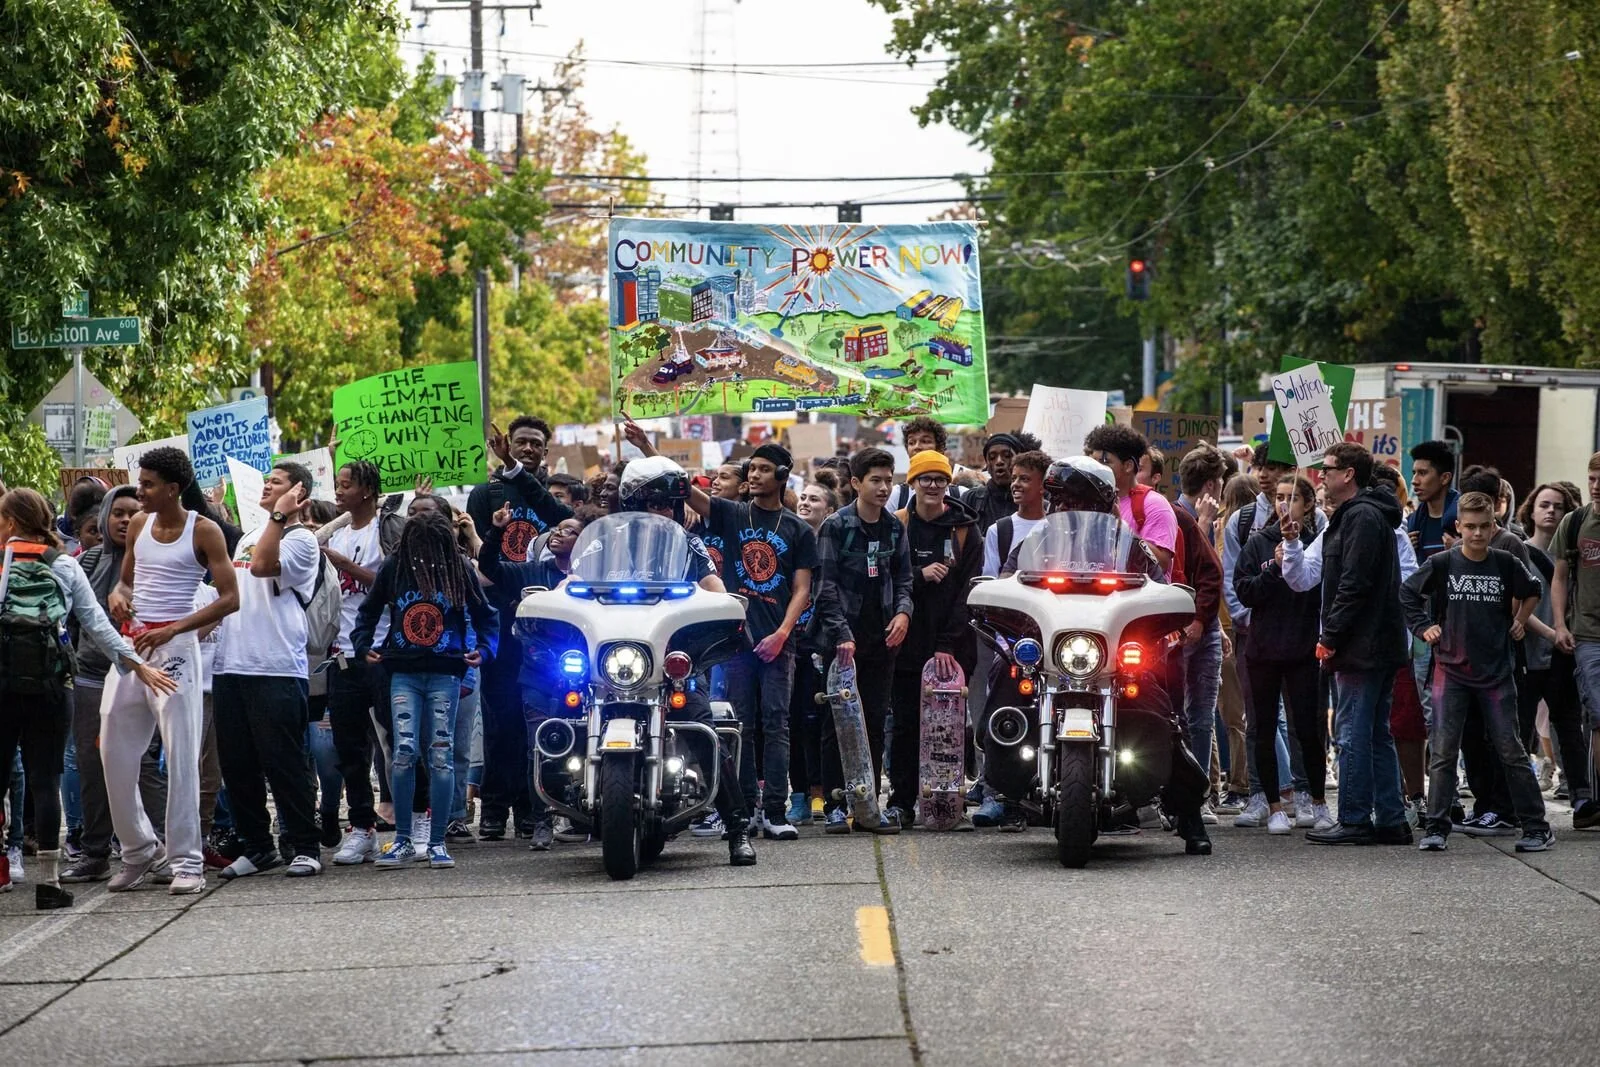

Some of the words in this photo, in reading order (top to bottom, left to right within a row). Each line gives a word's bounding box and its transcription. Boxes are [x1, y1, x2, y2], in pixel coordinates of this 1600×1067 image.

[614, 239, 776, 271] COMMUNITY
[791, 245, 889, 276] POWER
[899, 244, 972, 273] NOW!
[95, 327, 120, 341] Ave
[119, 319, 137, 329] 600
[378, 368, 425, 388] THE
[359, 382, 464, 409] CLIMATE
[340, 415, 365, 433] IS
[367, 404, 472, 425] CHANGING
[1298, 405, 1320, 423] NOT
[194, 419, 249, 443] ADULTS
[252, 415, 269, 431] act
[383, 426, 431, 445] WHY
[1142, 418, 1172, 437] THE
[1177, 418, 1219, 438] DINOS
[222, 432, 269, 452] CHILDREN
[1448, 574, 1501, 594] VANS
[1449, 593, 1463, 601] OFF
[1466, 594, 1480, 602] THE
